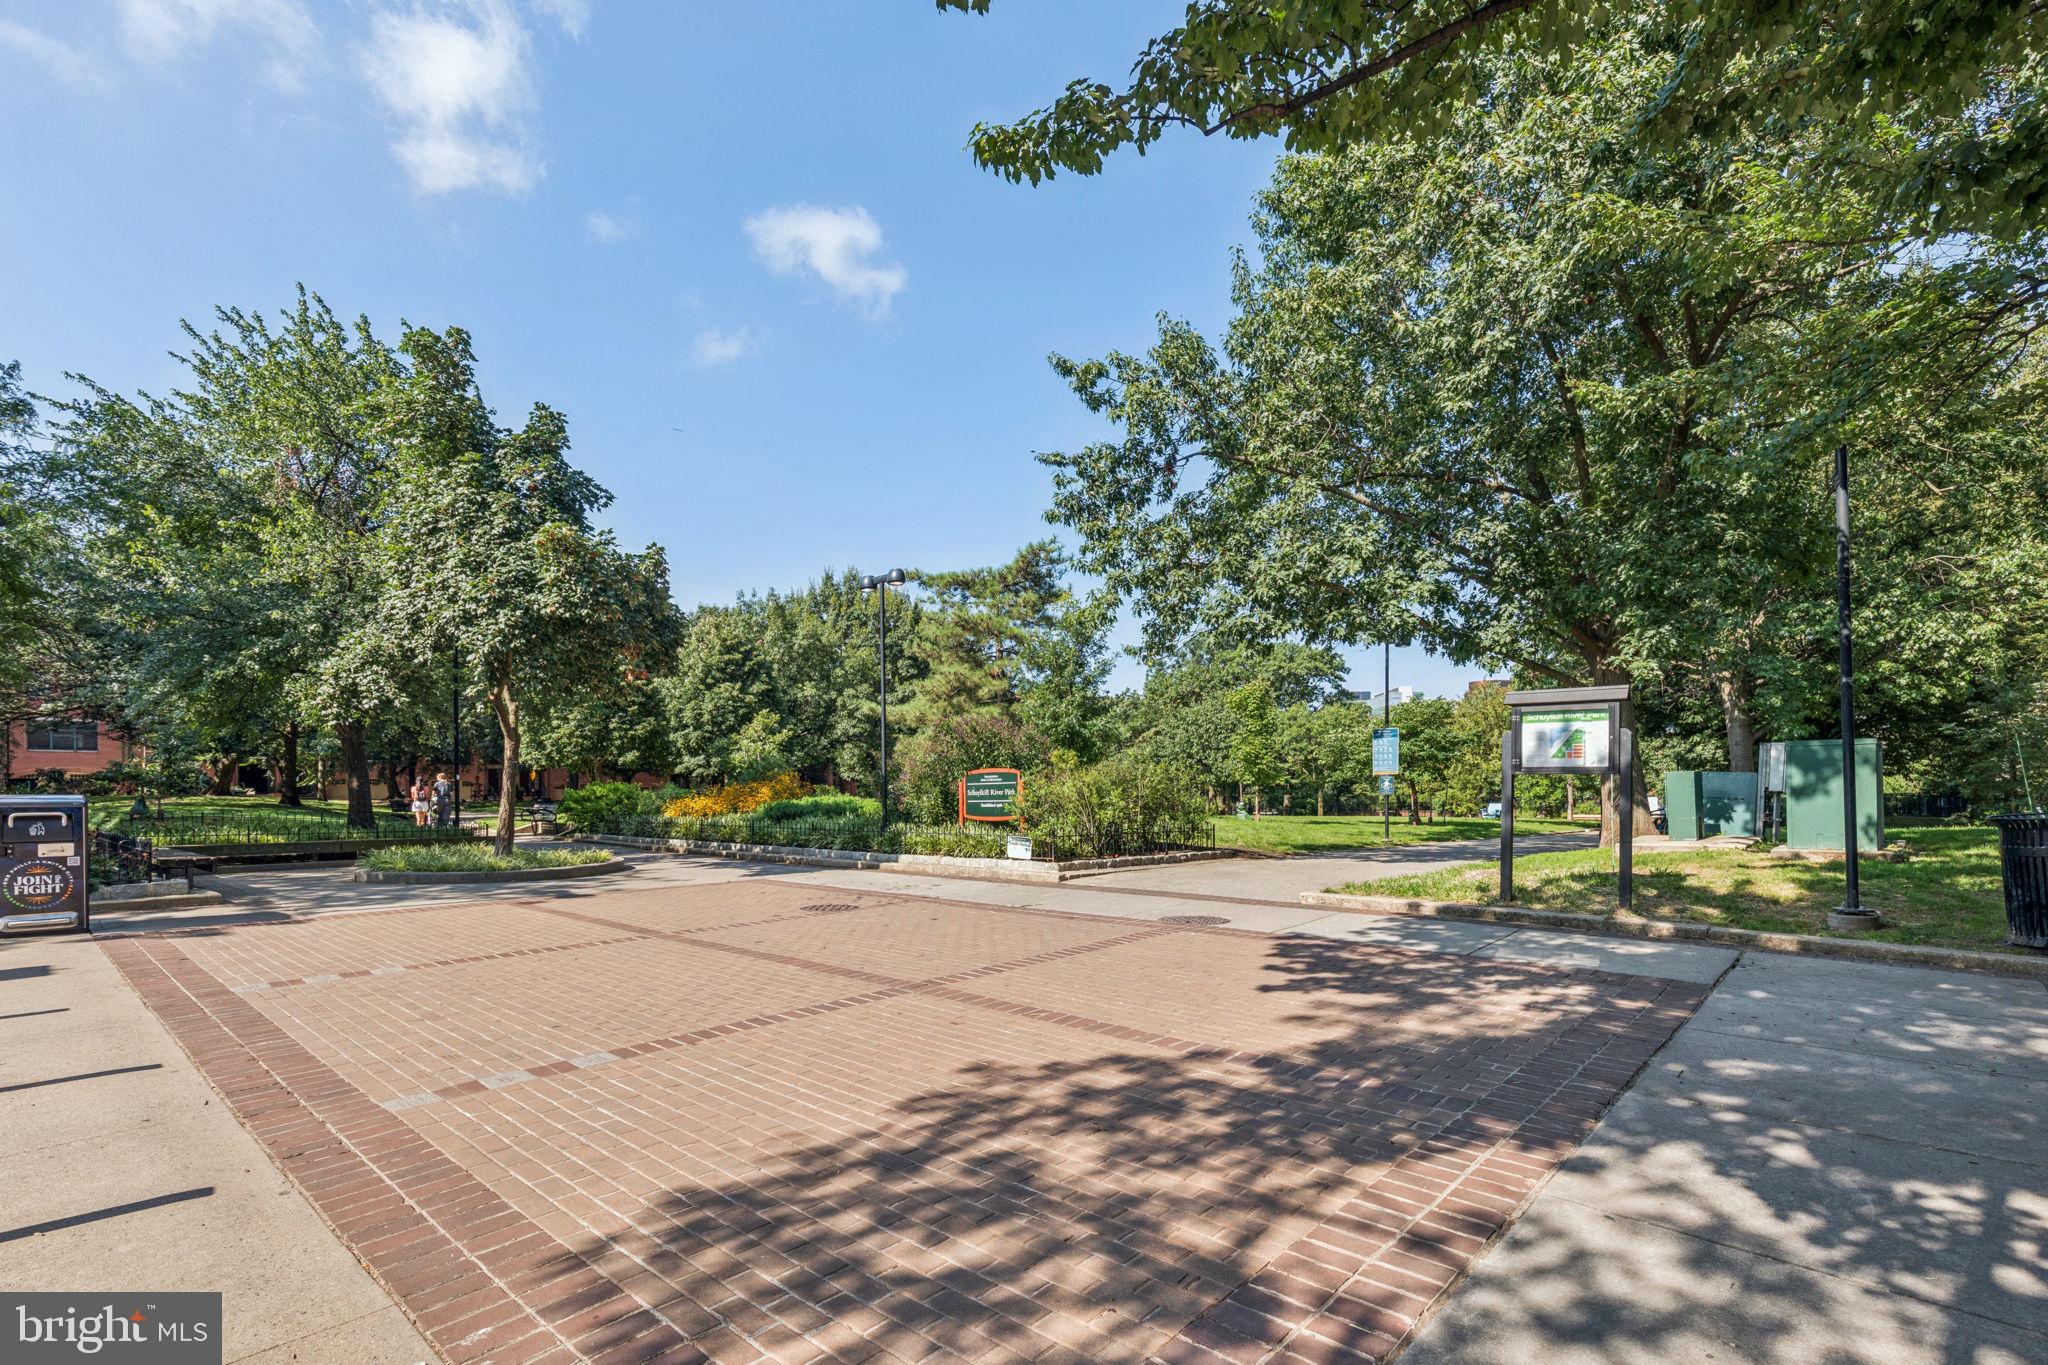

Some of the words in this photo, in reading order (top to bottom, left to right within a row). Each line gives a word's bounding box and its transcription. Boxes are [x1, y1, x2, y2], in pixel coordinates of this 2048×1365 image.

[1565, 711, 1584, 719] River
[42, 860, 66, 870] UNITED
[13, 875, 52, 886] JOIN
[14, 883, 64, 895] FIGHT
